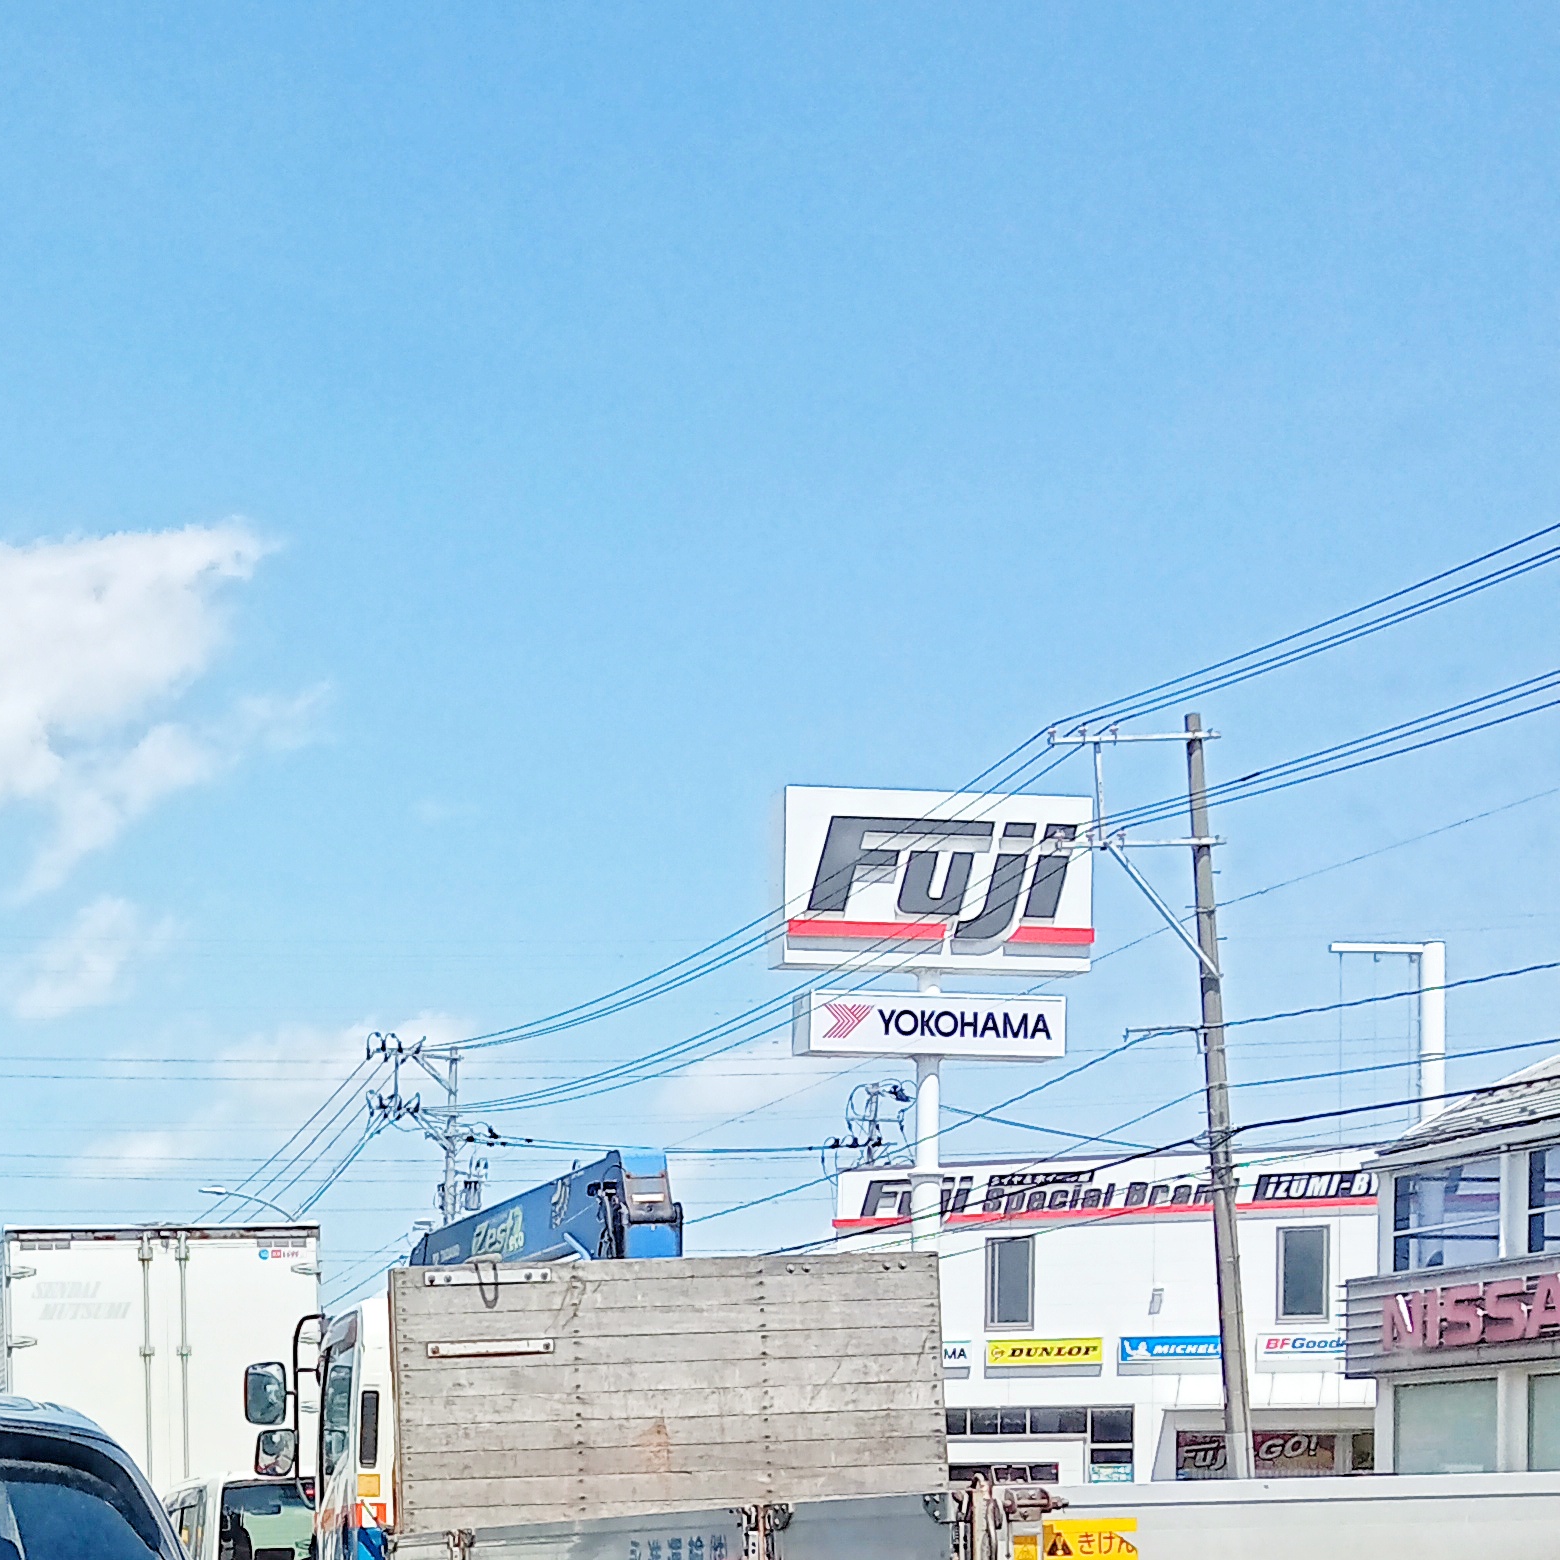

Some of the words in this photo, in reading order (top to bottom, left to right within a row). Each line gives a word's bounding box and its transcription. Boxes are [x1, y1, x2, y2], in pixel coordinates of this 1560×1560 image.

[878, 1008, 1052, 1041] YOKOHAMA
[983, 1182, 1116, 1215] Special
[1125, 1176, 1240, 1207] Bran
[1008, 1345, 1098, 1358] DUNLOP
[1152, 1343, 1221, 1355] MICHEL
[1259, 1433, 1319, 1460] GO!
